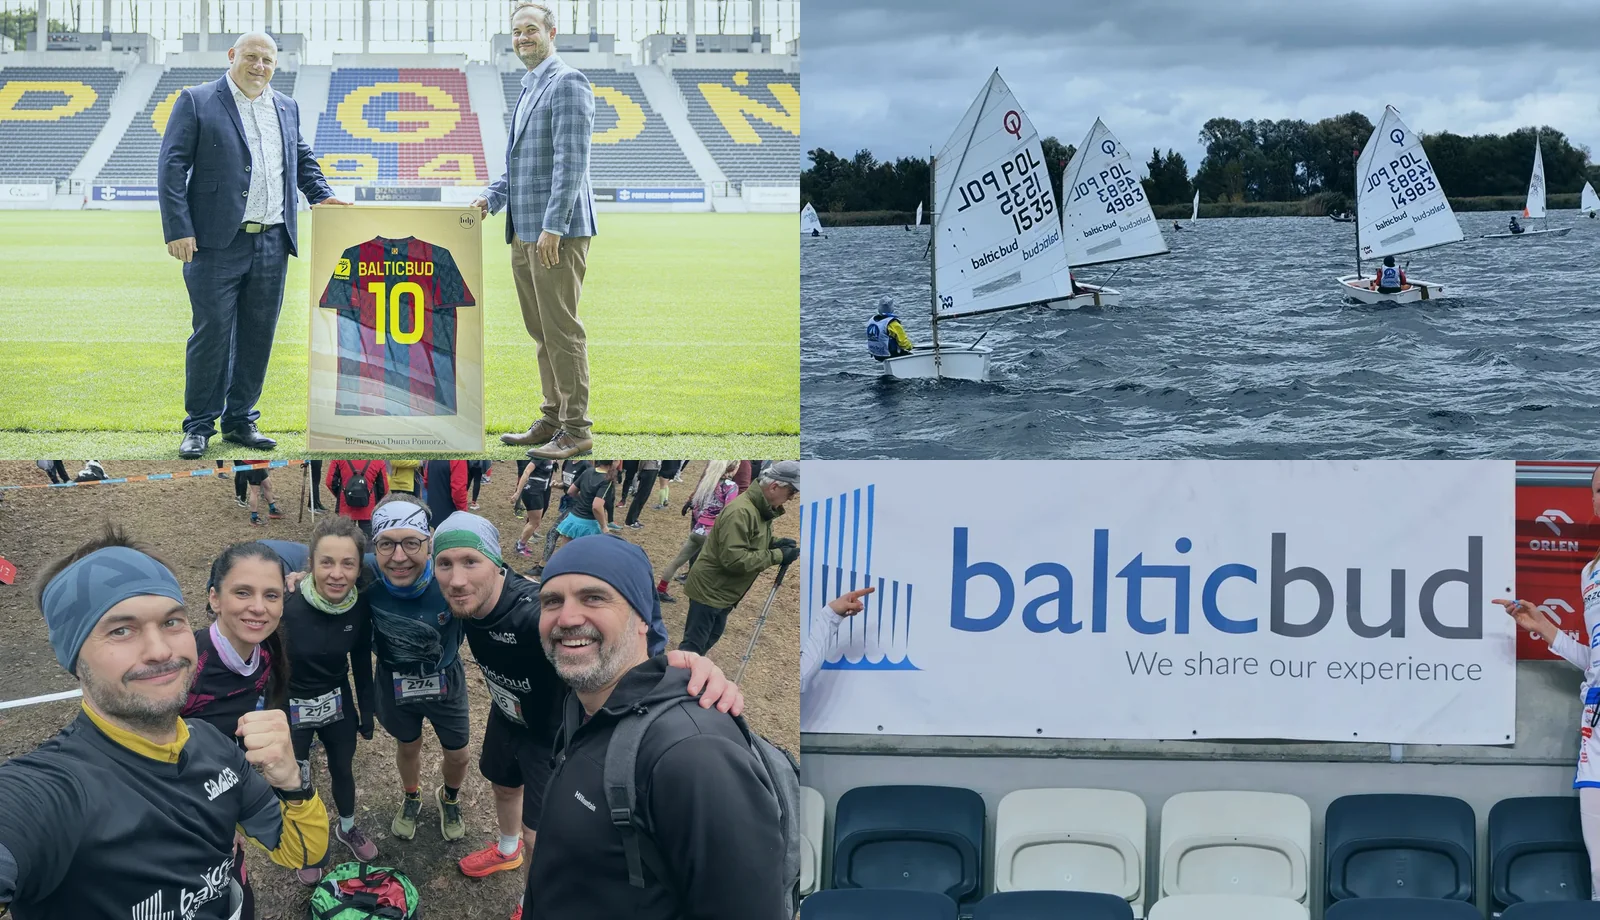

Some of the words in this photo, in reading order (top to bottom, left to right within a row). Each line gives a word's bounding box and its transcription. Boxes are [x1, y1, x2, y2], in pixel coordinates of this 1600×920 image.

[1001, 148, 1041, 186] POL
[1099, 163, 1131, 185] POL
[1389, 152, 1422, 175] POL
[1106, 187, 1144, 214] 4983
[1391, 176, 1436, 210] 14983
[1012, 190, 1053, 235] 1535
[358, 261, 434, 276] BALTICBUD
[367, 281, 425, 345] 10
[1529, 539, 1579, 552] ORLEN
[950, 526, 1484, 640] balticbud
[1125, 650, 1173, 676] We
[1184, 650, 1259, 676] share
[1269, 659, 1317, 678] our
[1326, 655, 1483, 684] experience
[407, 679, 434, 690] 274
[305, 702, 331, 717] 275
